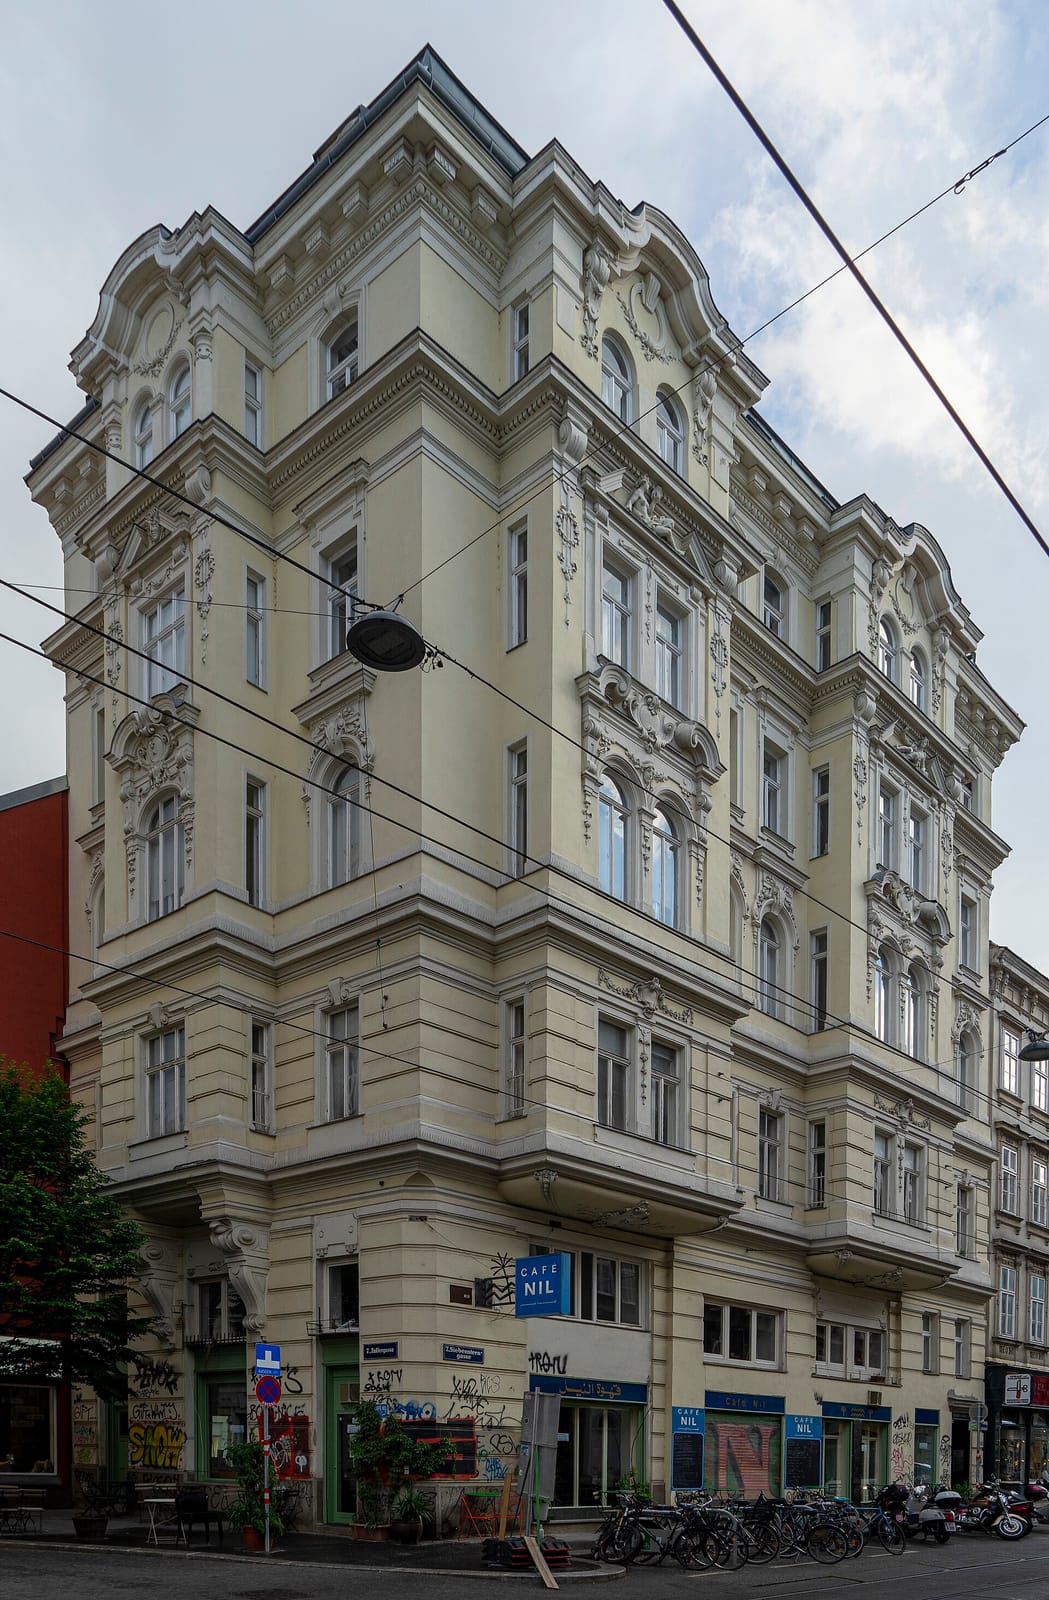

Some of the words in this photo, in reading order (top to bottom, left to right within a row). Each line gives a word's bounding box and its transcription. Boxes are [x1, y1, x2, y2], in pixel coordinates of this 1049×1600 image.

[524, 1280, 554, 1297] NIL
[680, 1416, 697, 1426] NIL
[797, 1424, 812, 1433] NIL
